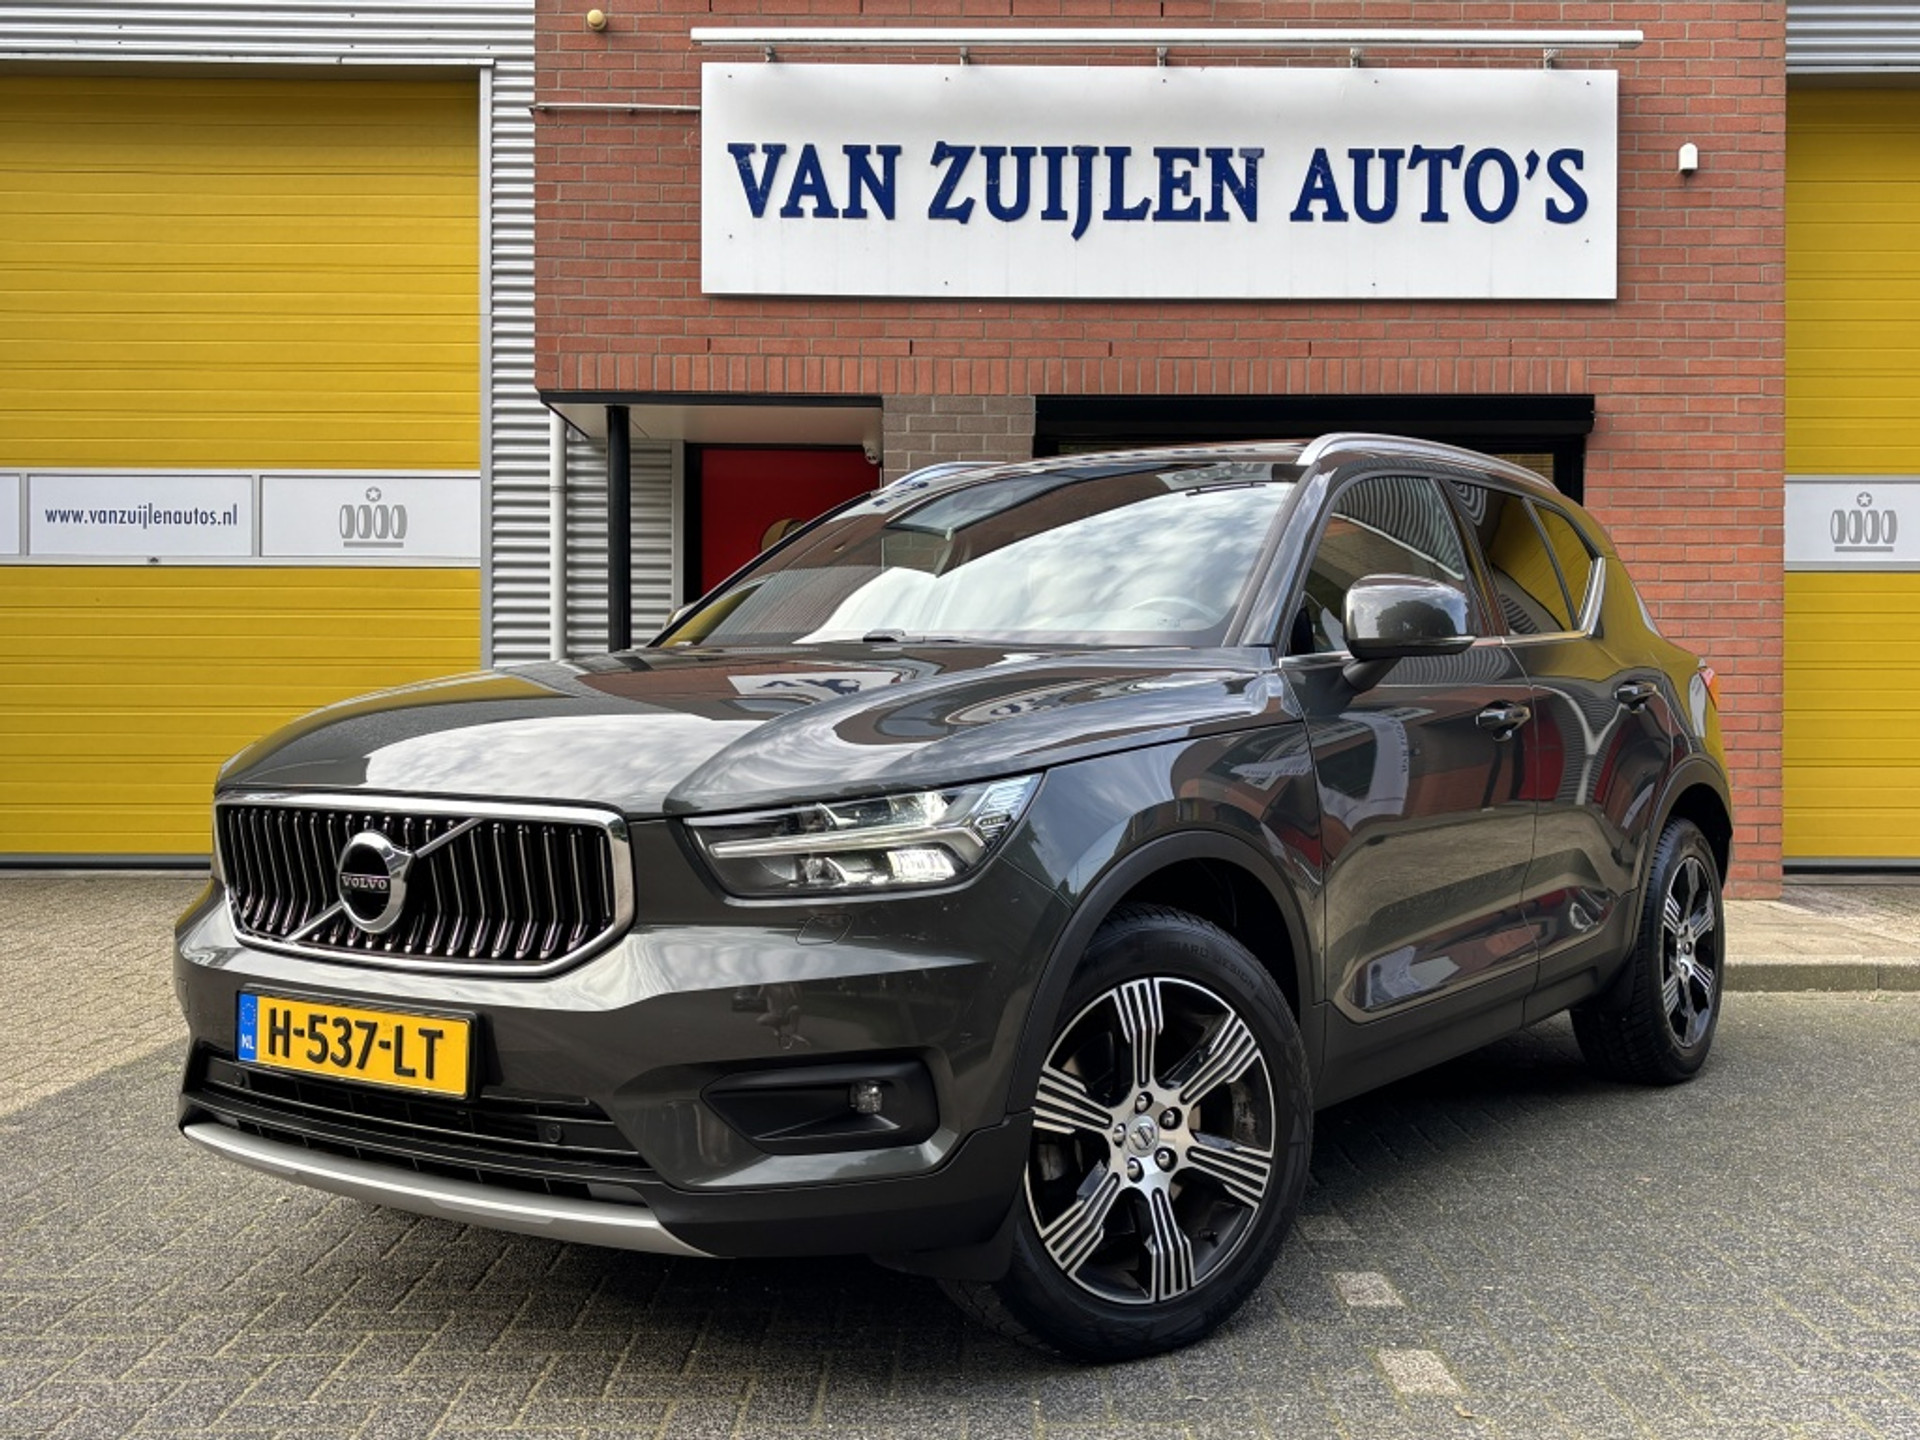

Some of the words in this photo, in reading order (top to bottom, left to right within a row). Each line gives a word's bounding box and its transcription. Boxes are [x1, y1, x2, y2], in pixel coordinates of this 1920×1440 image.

[727, 143, 903, 221] VAN
[928, 141, 1265, 241] ZUIJLEN
[1290, 145, 1589, 225] AUTO'S
[45, 503, 238, 530] www.vanzuijlenautos.nl
[341, 875, 388, 890] VOLVO
[241, 1033, 254, 1050] NL
[267, 1007, 444, 1080] H-537-LT
